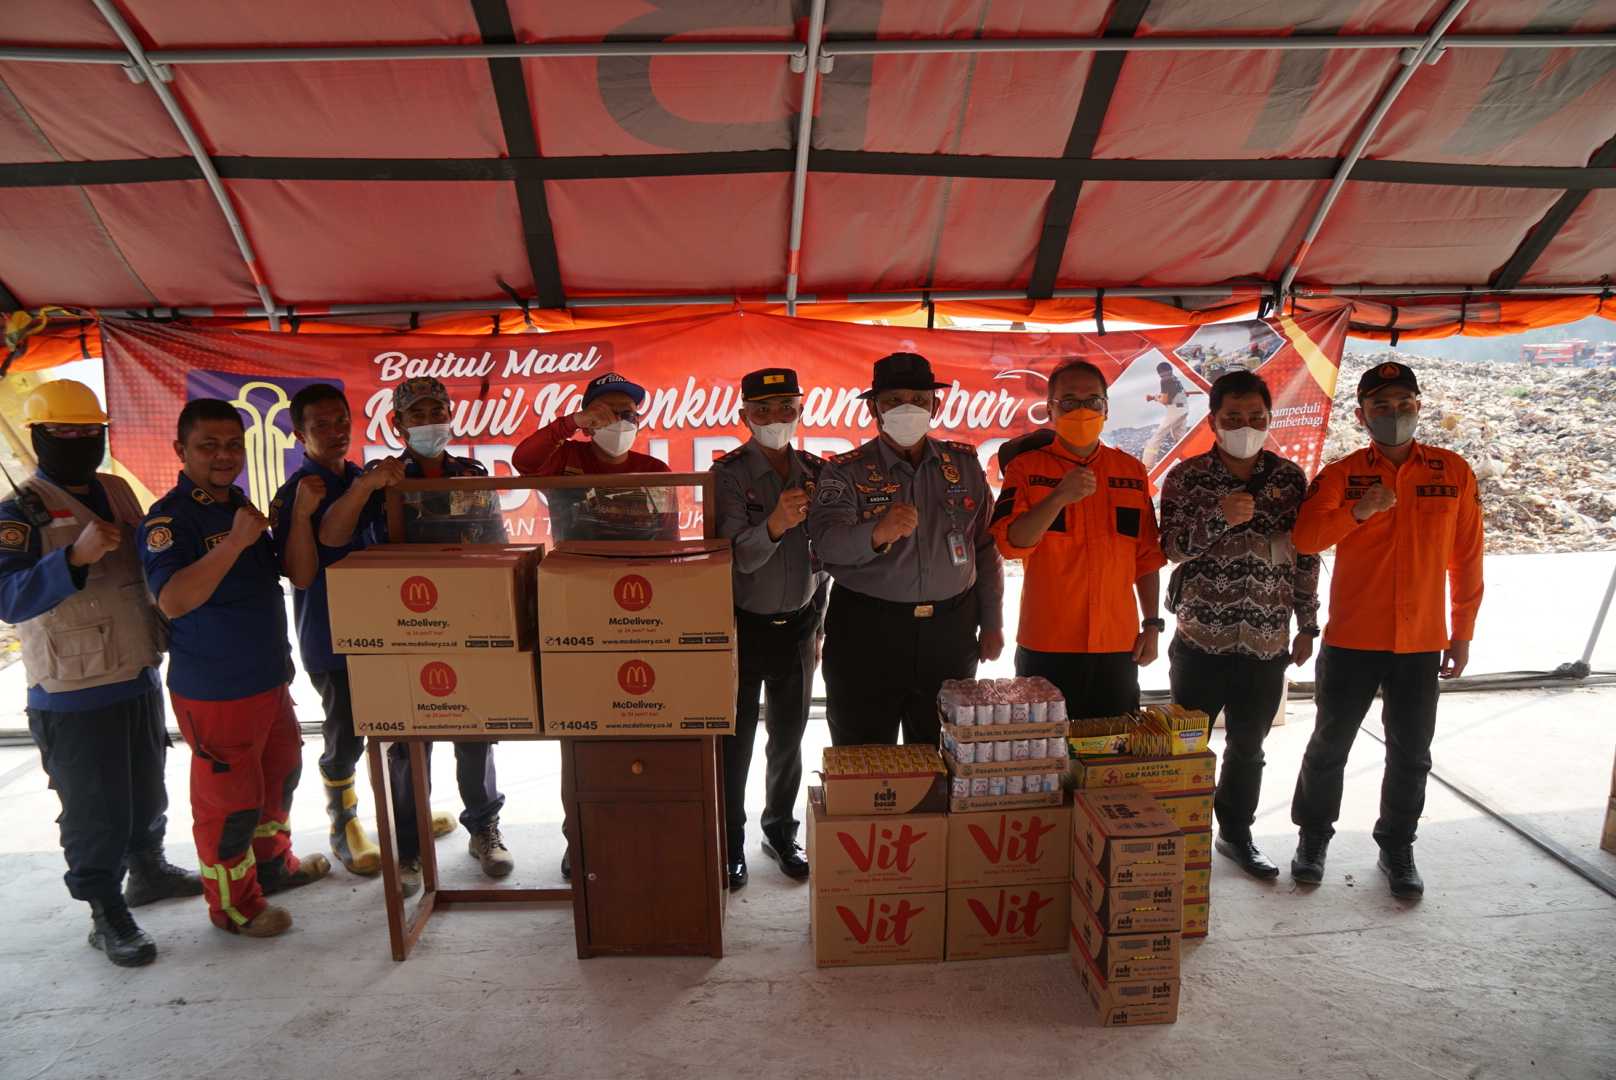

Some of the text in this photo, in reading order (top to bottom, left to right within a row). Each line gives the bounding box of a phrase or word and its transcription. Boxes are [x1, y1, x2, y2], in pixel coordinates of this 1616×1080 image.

[374, 346, 602, 381] Baitul Maal
[365, 386, 530, 449] Kwil
[930, 379, 1024, 429] bar
[1271, 402, 1320, 417] ampeduli
[1270, 416, 1324, 429] amberbagi
[346, 638, 384, 648] 14045
[555, 636, 594, 646] 14045
[368, 721, 405, 731] 14045
[560, 720, 598, 730] 14045
[836, 822, 928, 873] Vit
[967, 815, 1056, 864] Vit
[836, 897, 925, 945] Vit
[967, 889, 1054, 937] Vit
